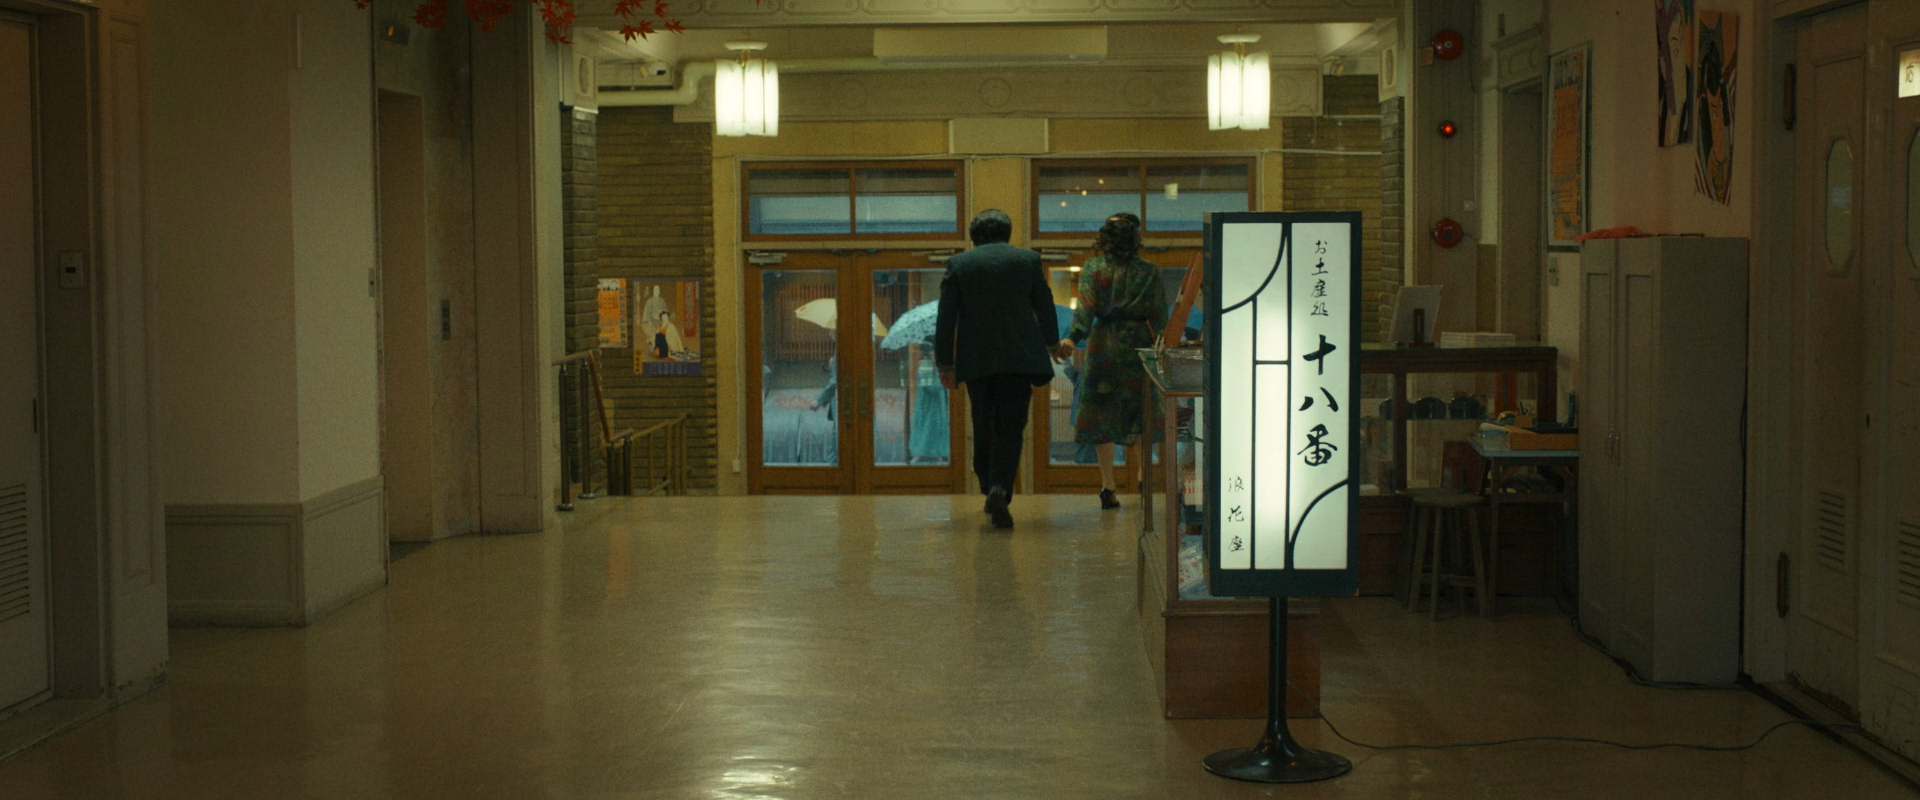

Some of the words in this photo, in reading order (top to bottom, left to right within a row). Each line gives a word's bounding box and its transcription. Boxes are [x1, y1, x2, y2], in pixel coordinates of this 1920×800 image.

[1310, 239, 1329, 317] お土産処
[1298, 334, 1339, 467] 十八番
[1227, 475, 1245, 552] 浪花座
